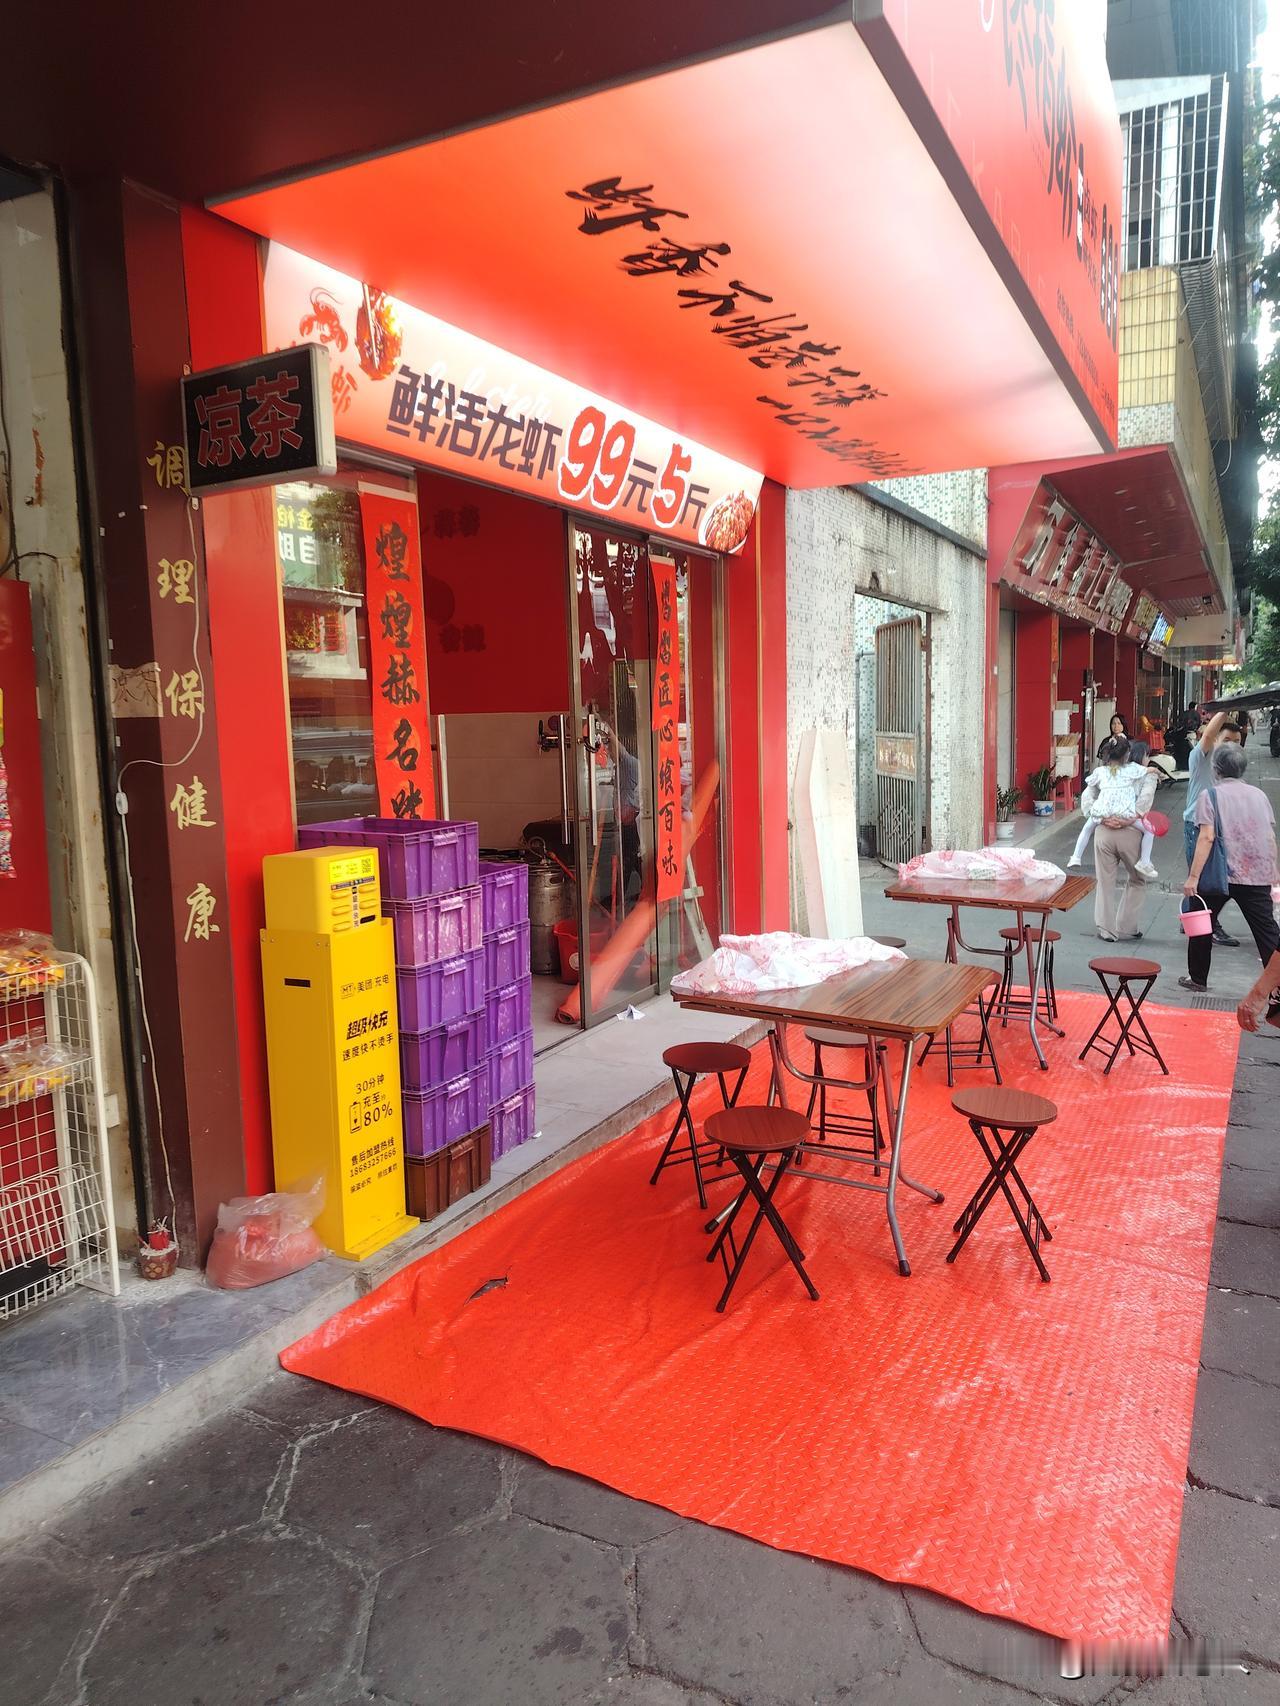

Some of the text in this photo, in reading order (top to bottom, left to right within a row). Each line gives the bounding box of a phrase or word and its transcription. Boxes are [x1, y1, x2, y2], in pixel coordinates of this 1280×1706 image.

[194, 371, 303, 468] 凉茶
[146, 440, 220, 943] 调理保健康
[358, 978, 373, 992] 美团
[375, 974, 389, 987] 充电
[346, 1010, 389, 1040] 超级快充
[343, 1033, 394, 1061] 速度快不烫手
[356, 1074, 385, 1094] 30分钟
[364, 1101, 393, 1127] 80%
[351, 1137, 395, 1166] 售后加盟热线
